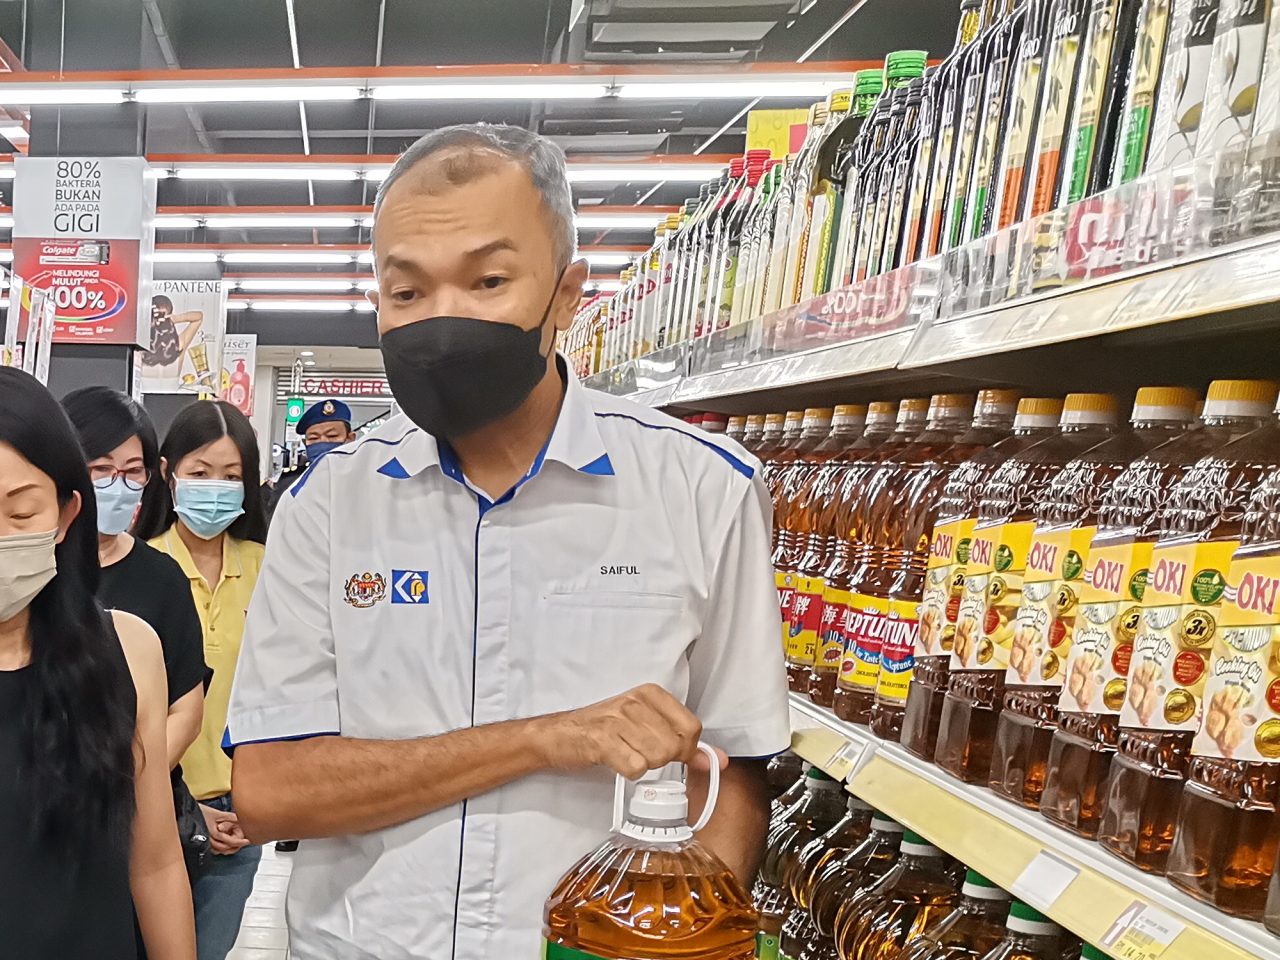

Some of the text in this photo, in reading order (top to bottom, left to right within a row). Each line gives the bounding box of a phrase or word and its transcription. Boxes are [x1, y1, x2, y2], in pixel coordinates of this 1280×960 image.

[56, 161, 101, 179] 80%
[55, 180, 101, 188] BAKTERIA
[55, 189, 101, 201] BUKAN
[54, 203, 100, 212] ADA PADA
[54, 213, 100, 233] GIGI
[42, 246, 76, 256] Colgate
[52, 269, 100, 278] MELINDUNGI
[52, 278, 83, 286] MULUT
[164, 281, 221, 294] PANTENE
[304, 379, 384, 395] CASHIER
[934, 533, 953, 559] OKI
[971, 538, 993, 566] OKI
[1029, 541, 1058, 573] OKI
[600, 565, 640, 575] SAIFUL
[1092, 558, 1124, 594] OKI
[1153, 558, 1187, 596] OKI
[1236, 572, 1280, 615] OKI
[1185, 619, 1207, 637] 3x
[1214, 656, 1263, 684] Cooking Oil
